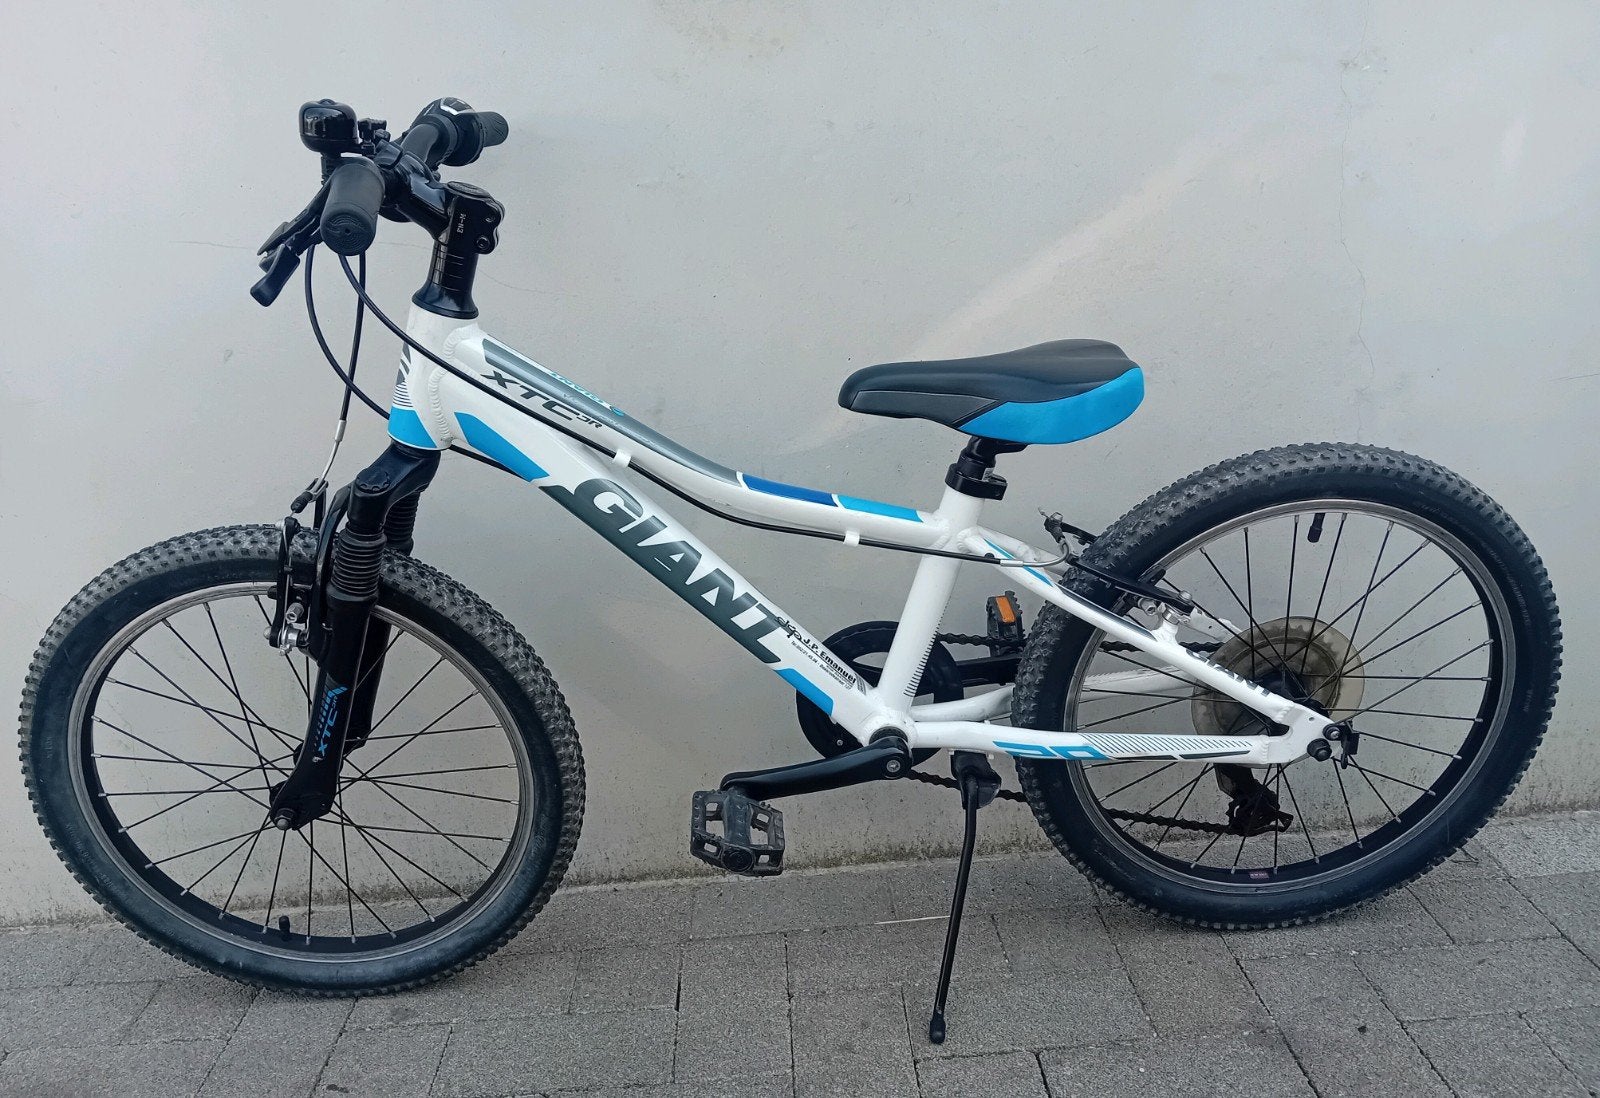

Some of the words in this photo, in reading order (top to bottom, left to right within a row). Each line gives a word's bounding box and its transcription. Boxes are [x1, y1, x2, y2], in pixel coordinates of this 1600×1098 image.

[481, 370, 572, 421] XTC
[538, 478, 781, 664] GIANT
[820, 650, 856, 684] Emanuel
[318, 707, 338, 757] XTC
